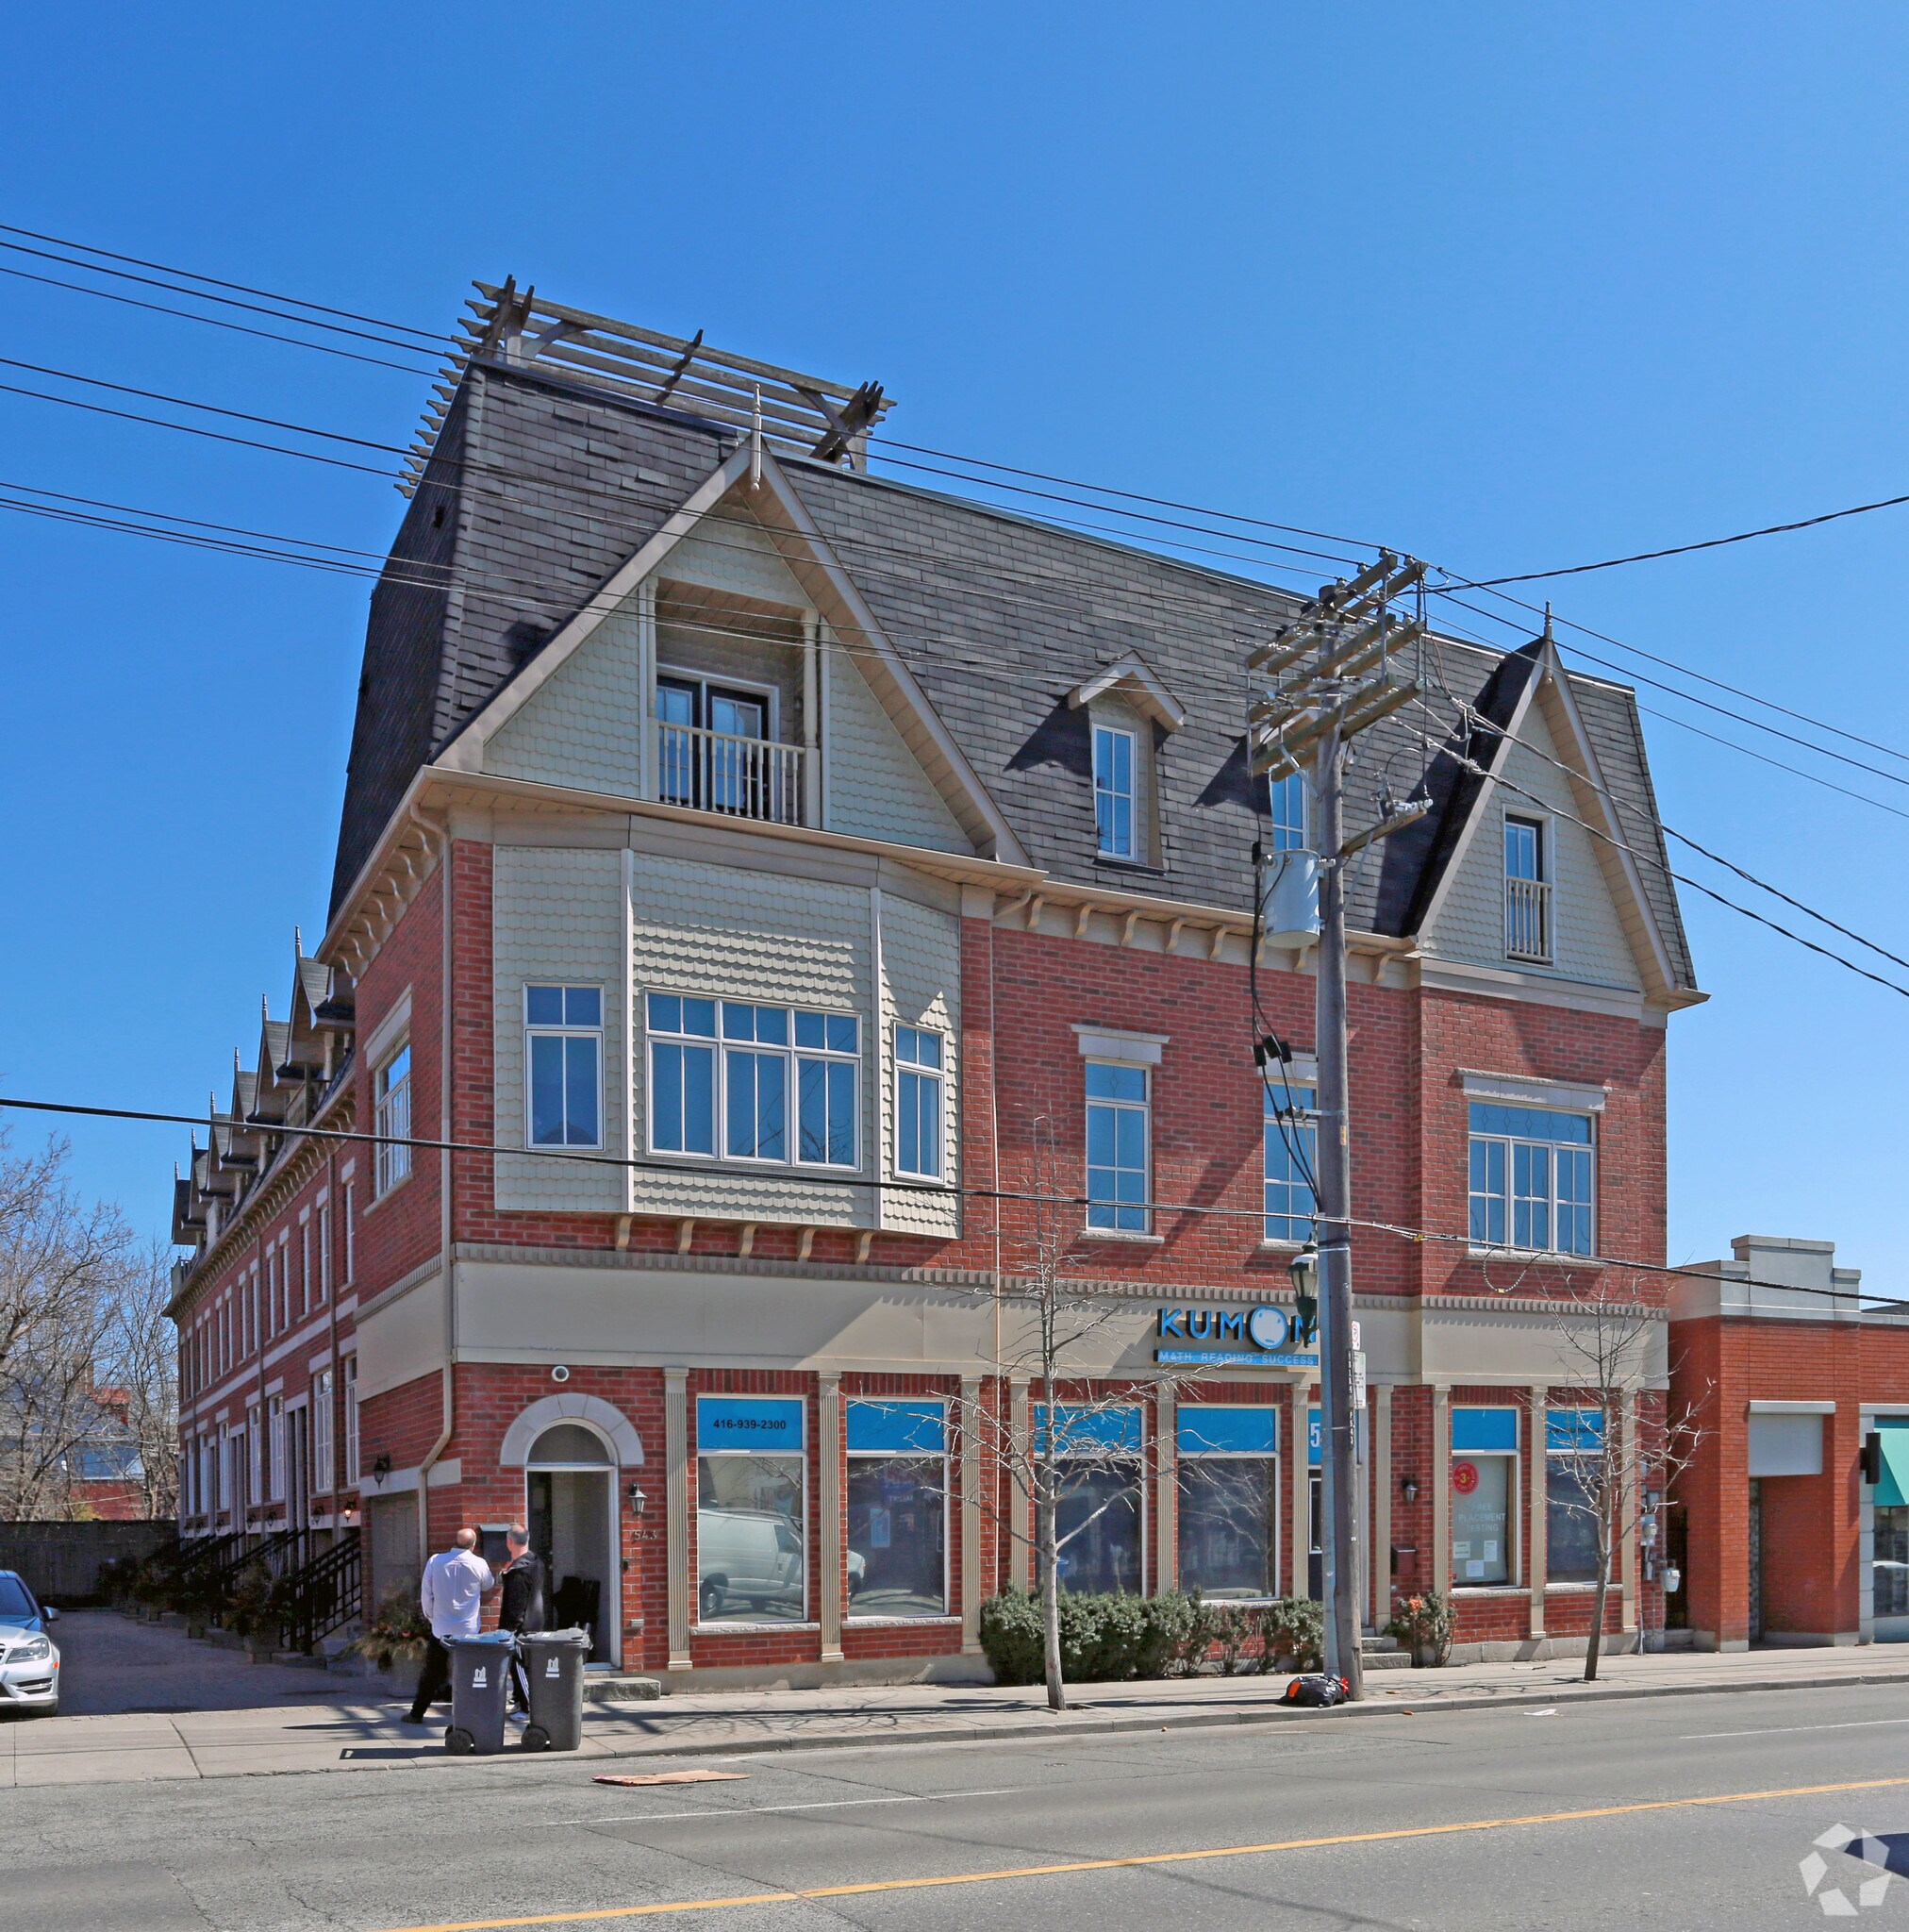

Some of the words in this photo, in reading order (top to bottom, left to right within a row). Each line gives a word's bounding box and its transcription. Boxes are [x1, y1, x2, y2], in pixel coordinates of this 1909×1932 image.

[713, 1419, 787, 1429] 416-939-2300
[1310, 1423, 1321, 1448] 5
[1458, 1512, 1506, 1522] PLACEMENT
[1466, 1524, 1500, 1532] TESTING
